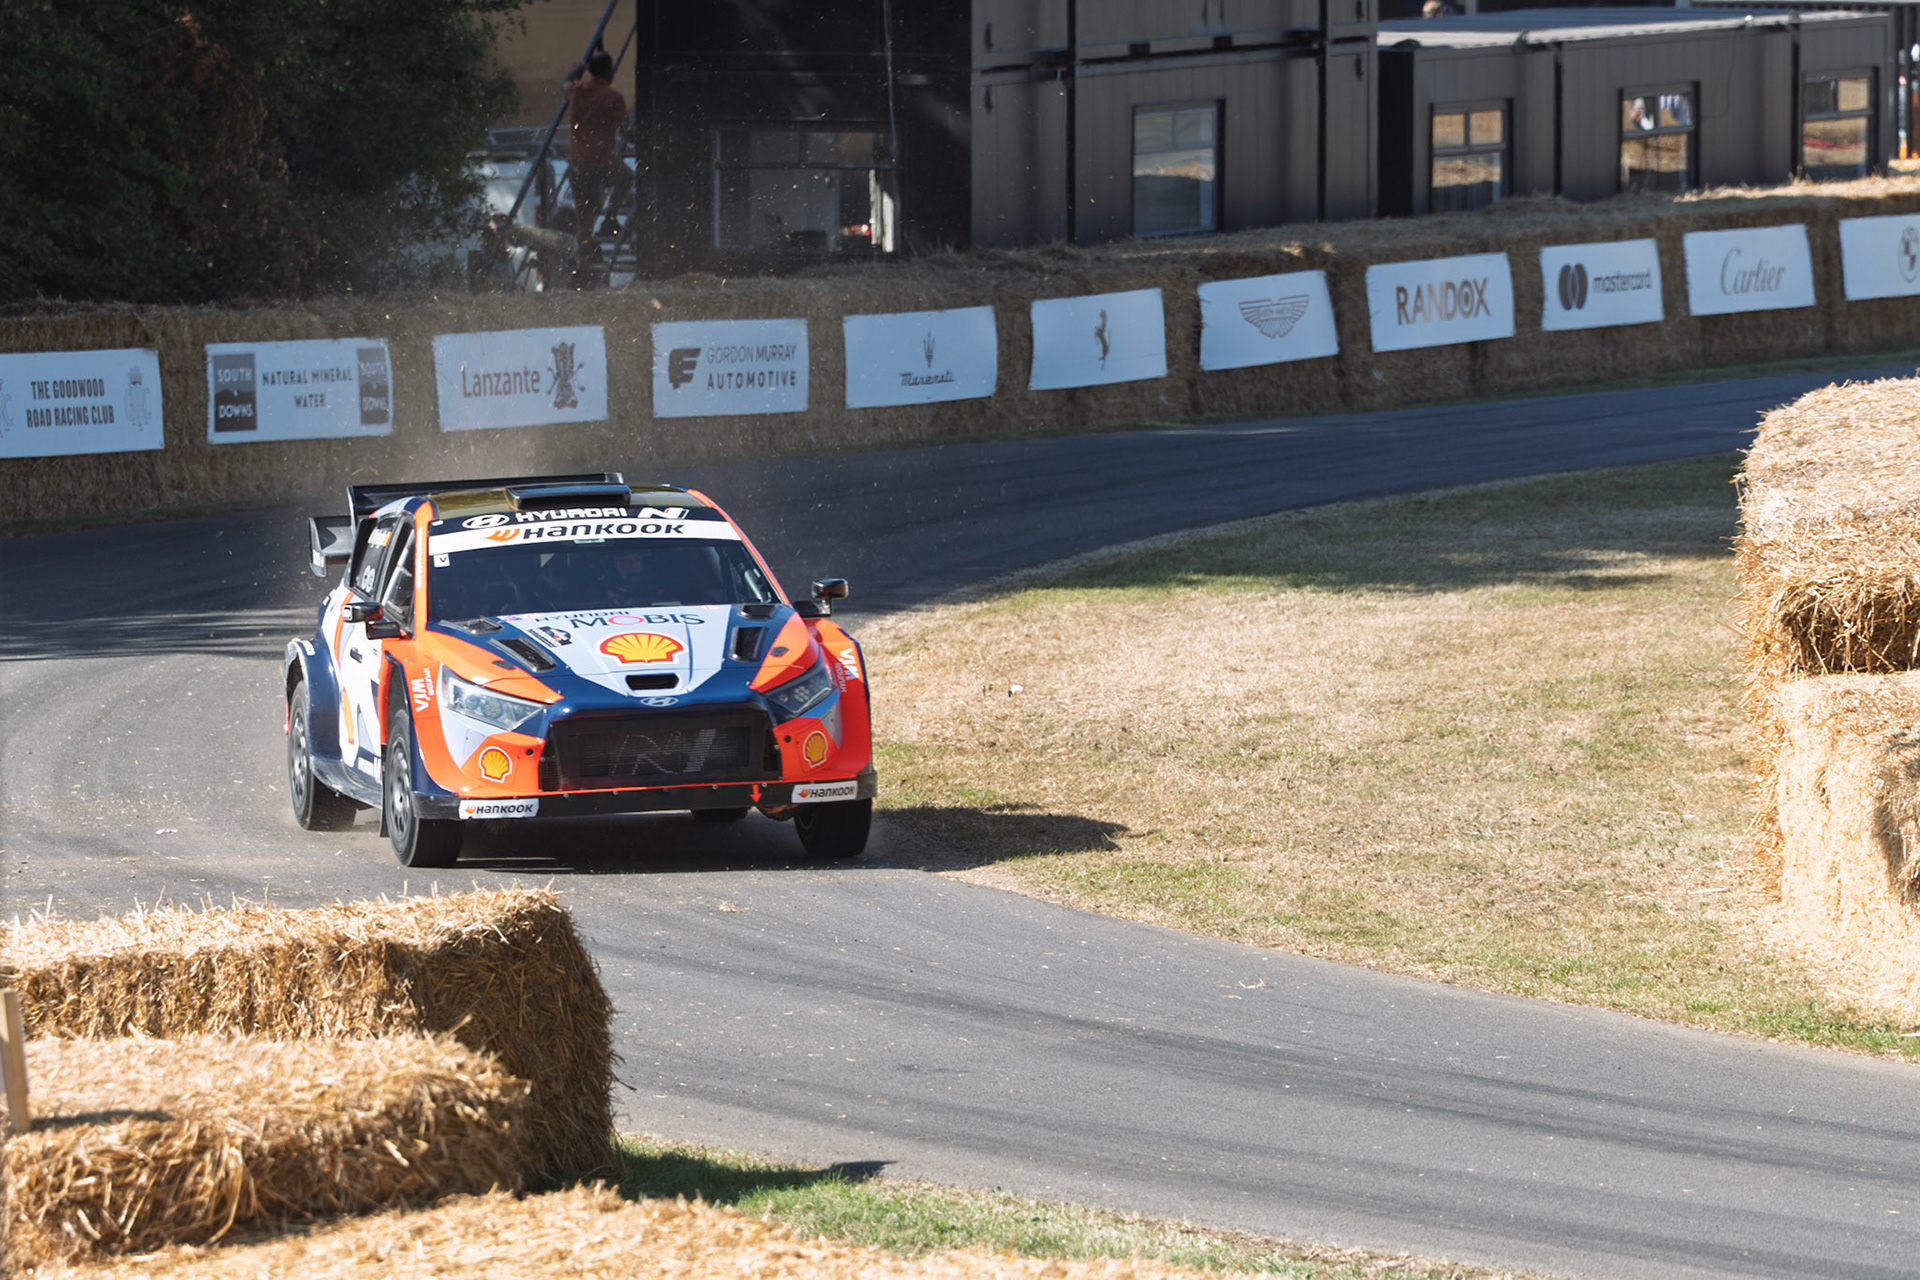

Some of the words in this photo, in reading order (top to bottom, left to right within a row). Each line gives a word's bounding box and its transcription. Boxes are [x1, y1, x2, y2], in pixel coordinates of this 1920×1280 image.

[1720, 247, 1787, 296] Cartier
[1395, 277, 1492, 326] RANDOX
[706, 346, 755, 365] GORDON
[756, 344, 797, 363] MURRAY
[217, 367, 253, 383] SOUTH
[261, 369, 308, 386] NATURAL
[311, 366, 353, 383] MINERAL
[460, 364, 541, 398] Lanzante
[706, 370, 797, 390] AUTOMOTIVE
[30, 380, 51, 400] THE
[52, 378, 105, 399] GOODWOOD
[293, 392, 326, 408] WATER
[26, 408, 52, 428] ROAD
[54, 405, 89, 426] RACING
[91, 404, 115, 425] CLUB
[218, 403, 254, 419] DOWNS
[515, 507, 628, 522] HYUNDAI
[535, 610, 630, 622] HYUNDAI
[570, 613, 705, 631] MOBIS
